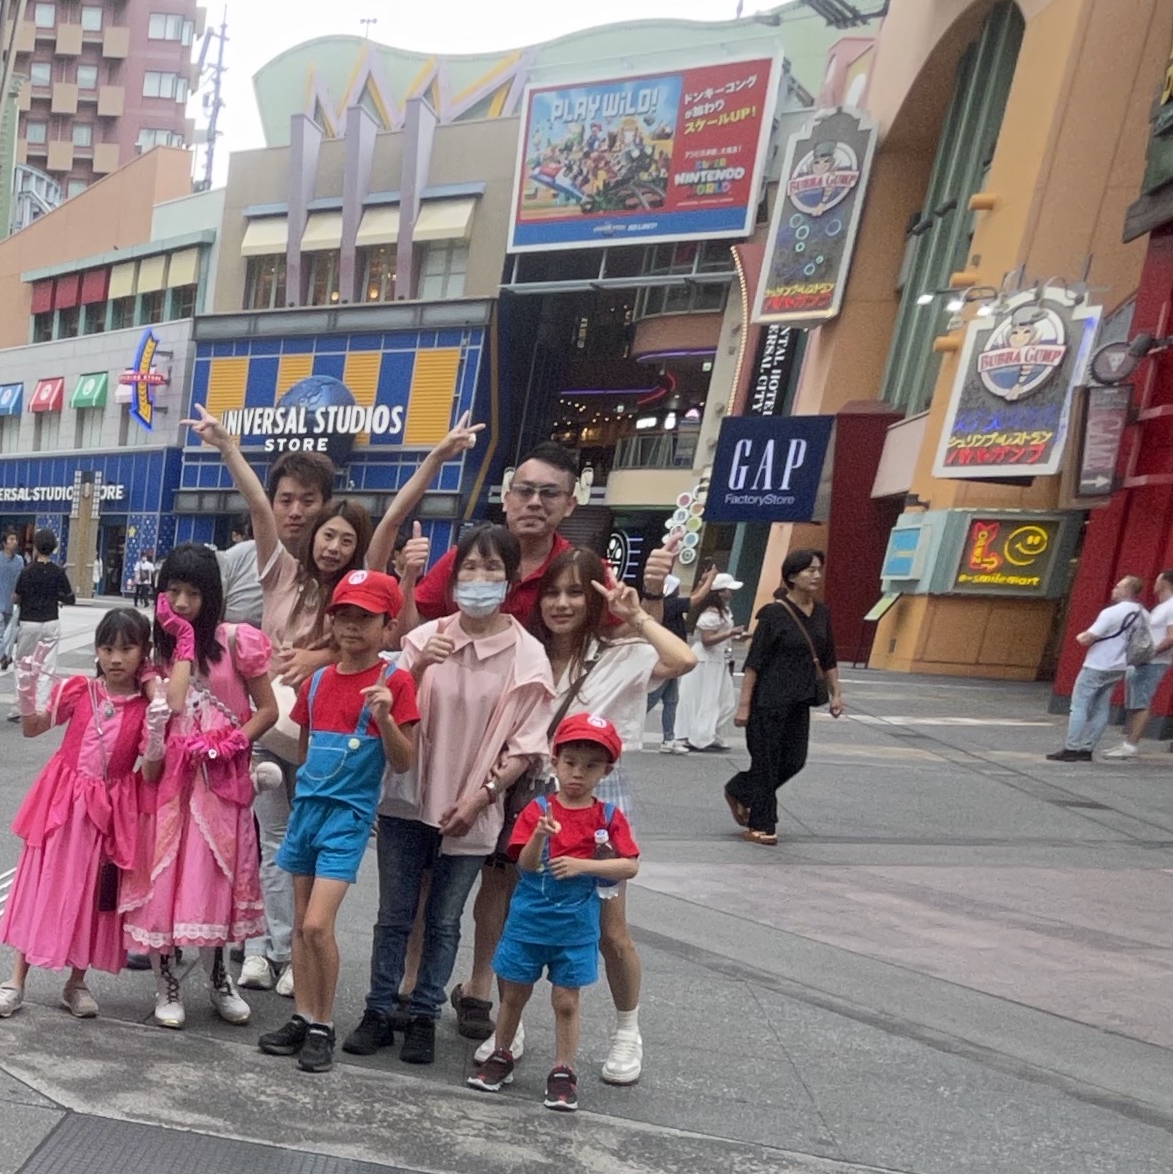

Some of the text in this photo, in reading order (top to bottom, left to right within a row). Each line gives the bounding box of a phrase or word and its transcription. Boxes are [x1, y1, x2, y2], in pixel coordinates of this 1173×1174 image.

[551, 96, 601, 122] PLAY
[674, 167, 745, 186] NINTENDO
[981, 349, 1062, 370] BUBBA GUMP
[752, 375, 768, 413] CITY
[313, 405, 404, 435] STUDIOS
[264, 438, 329, 452] STORE
[728, 439, 807, 491] GAP
